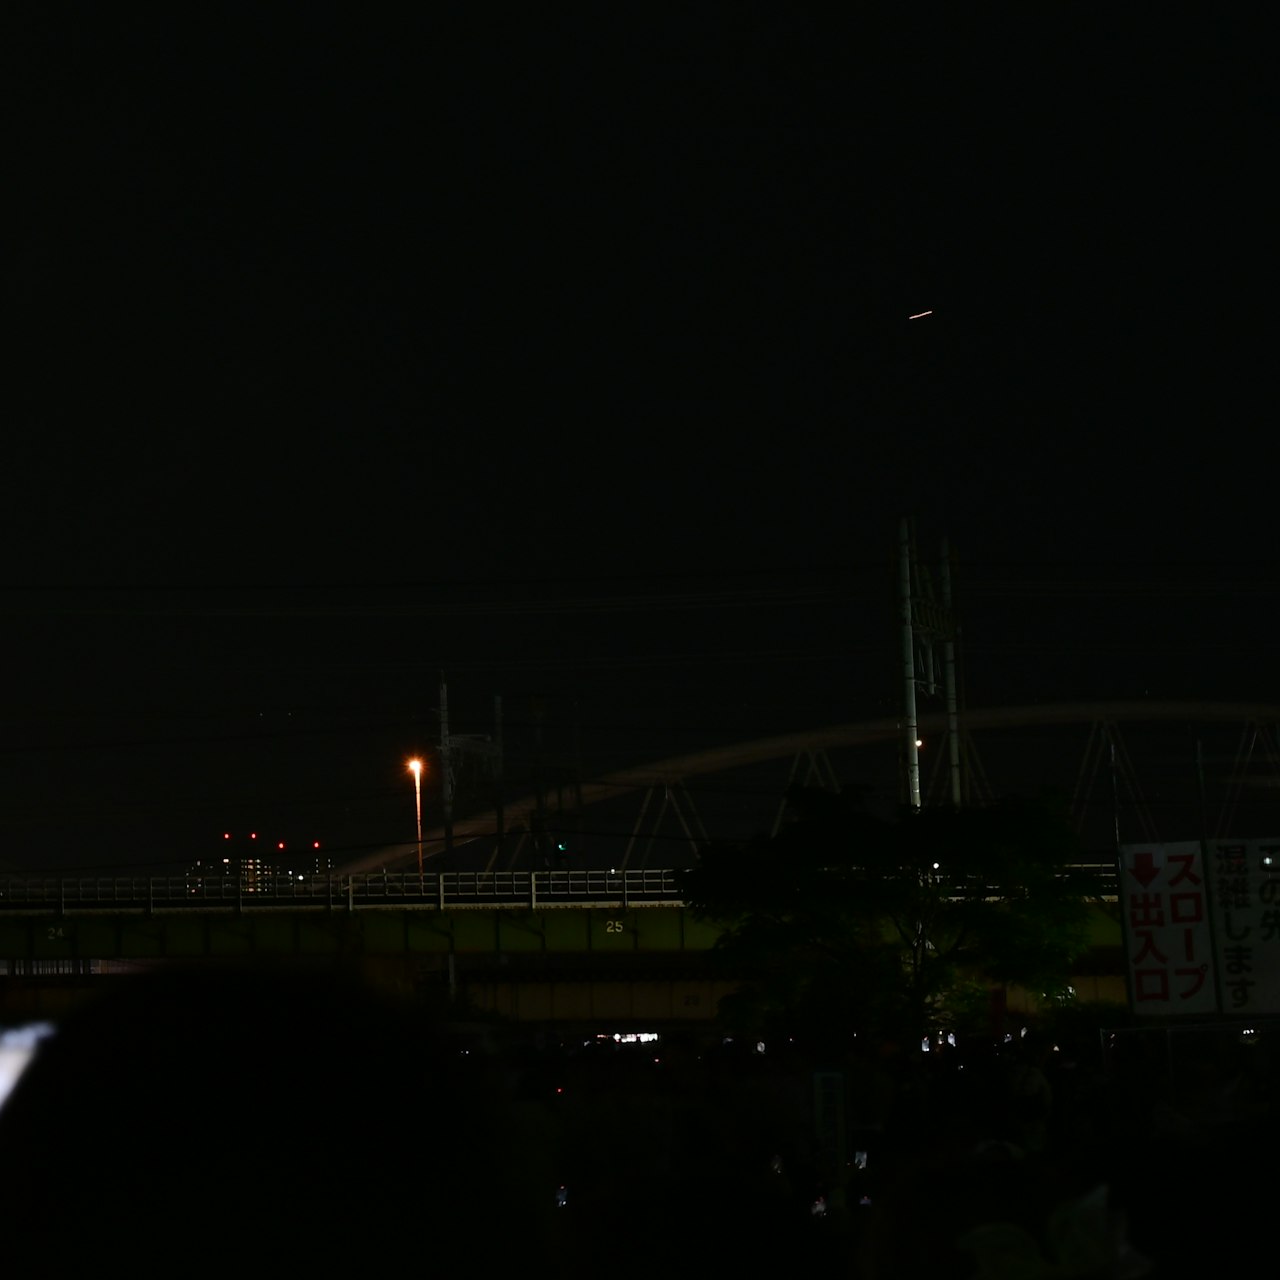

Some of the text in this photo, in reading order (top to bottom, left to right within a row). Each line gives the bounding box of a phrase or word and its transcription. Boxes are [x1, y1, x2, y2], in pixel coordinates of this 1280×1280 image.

[1129, 892, 1170, 1002] 出入口
[1167, 854, 1209, 1000] スロープ
